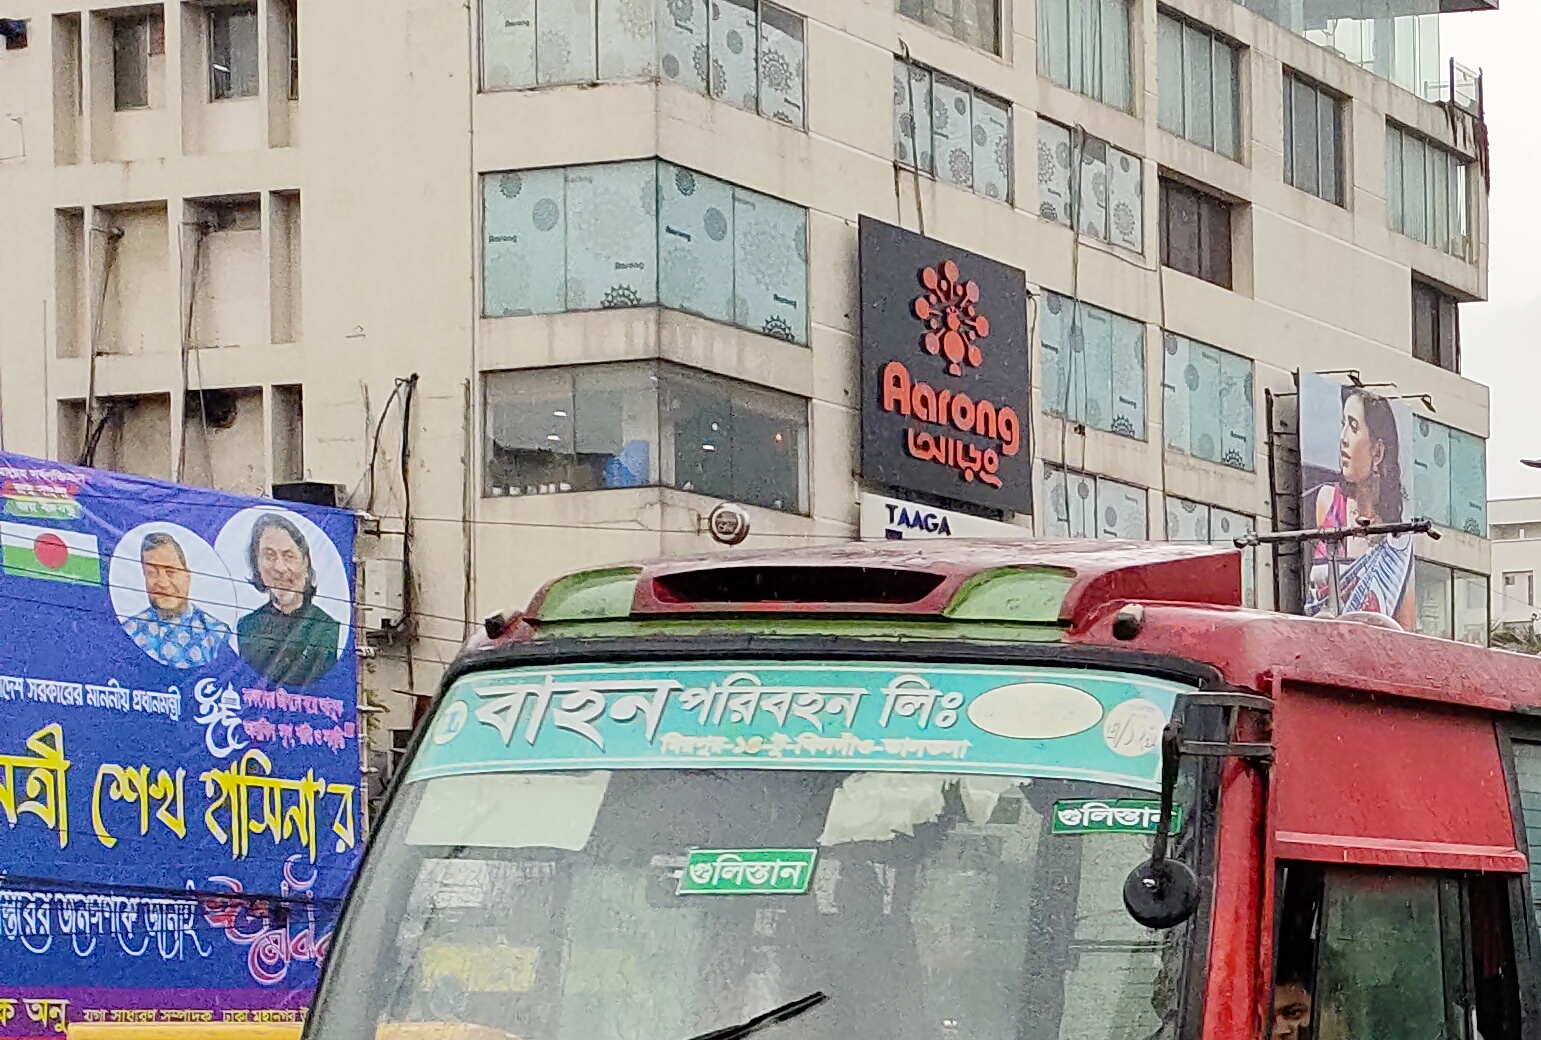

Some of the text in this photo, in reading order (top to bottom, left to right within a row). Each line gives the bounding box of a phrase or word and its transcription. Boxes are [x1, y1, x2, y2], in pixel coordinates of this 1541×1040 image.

[883, 360, 1020, 456] Aarong
[884, 503, 952, 537] TAAGA
[26, 678, 84, 706] সরকারের
[85, 678, 131, 713] মাননীয়
[132, 685, 182, 722] প্রধানমন্ত্রী
[475, 674, 686, 753] বাহন
[678, 672, 870, 733] পরিবহন
[92, 763, 187, 849] শেখ
[689, 853, 808, 886] গুলিস্তান
